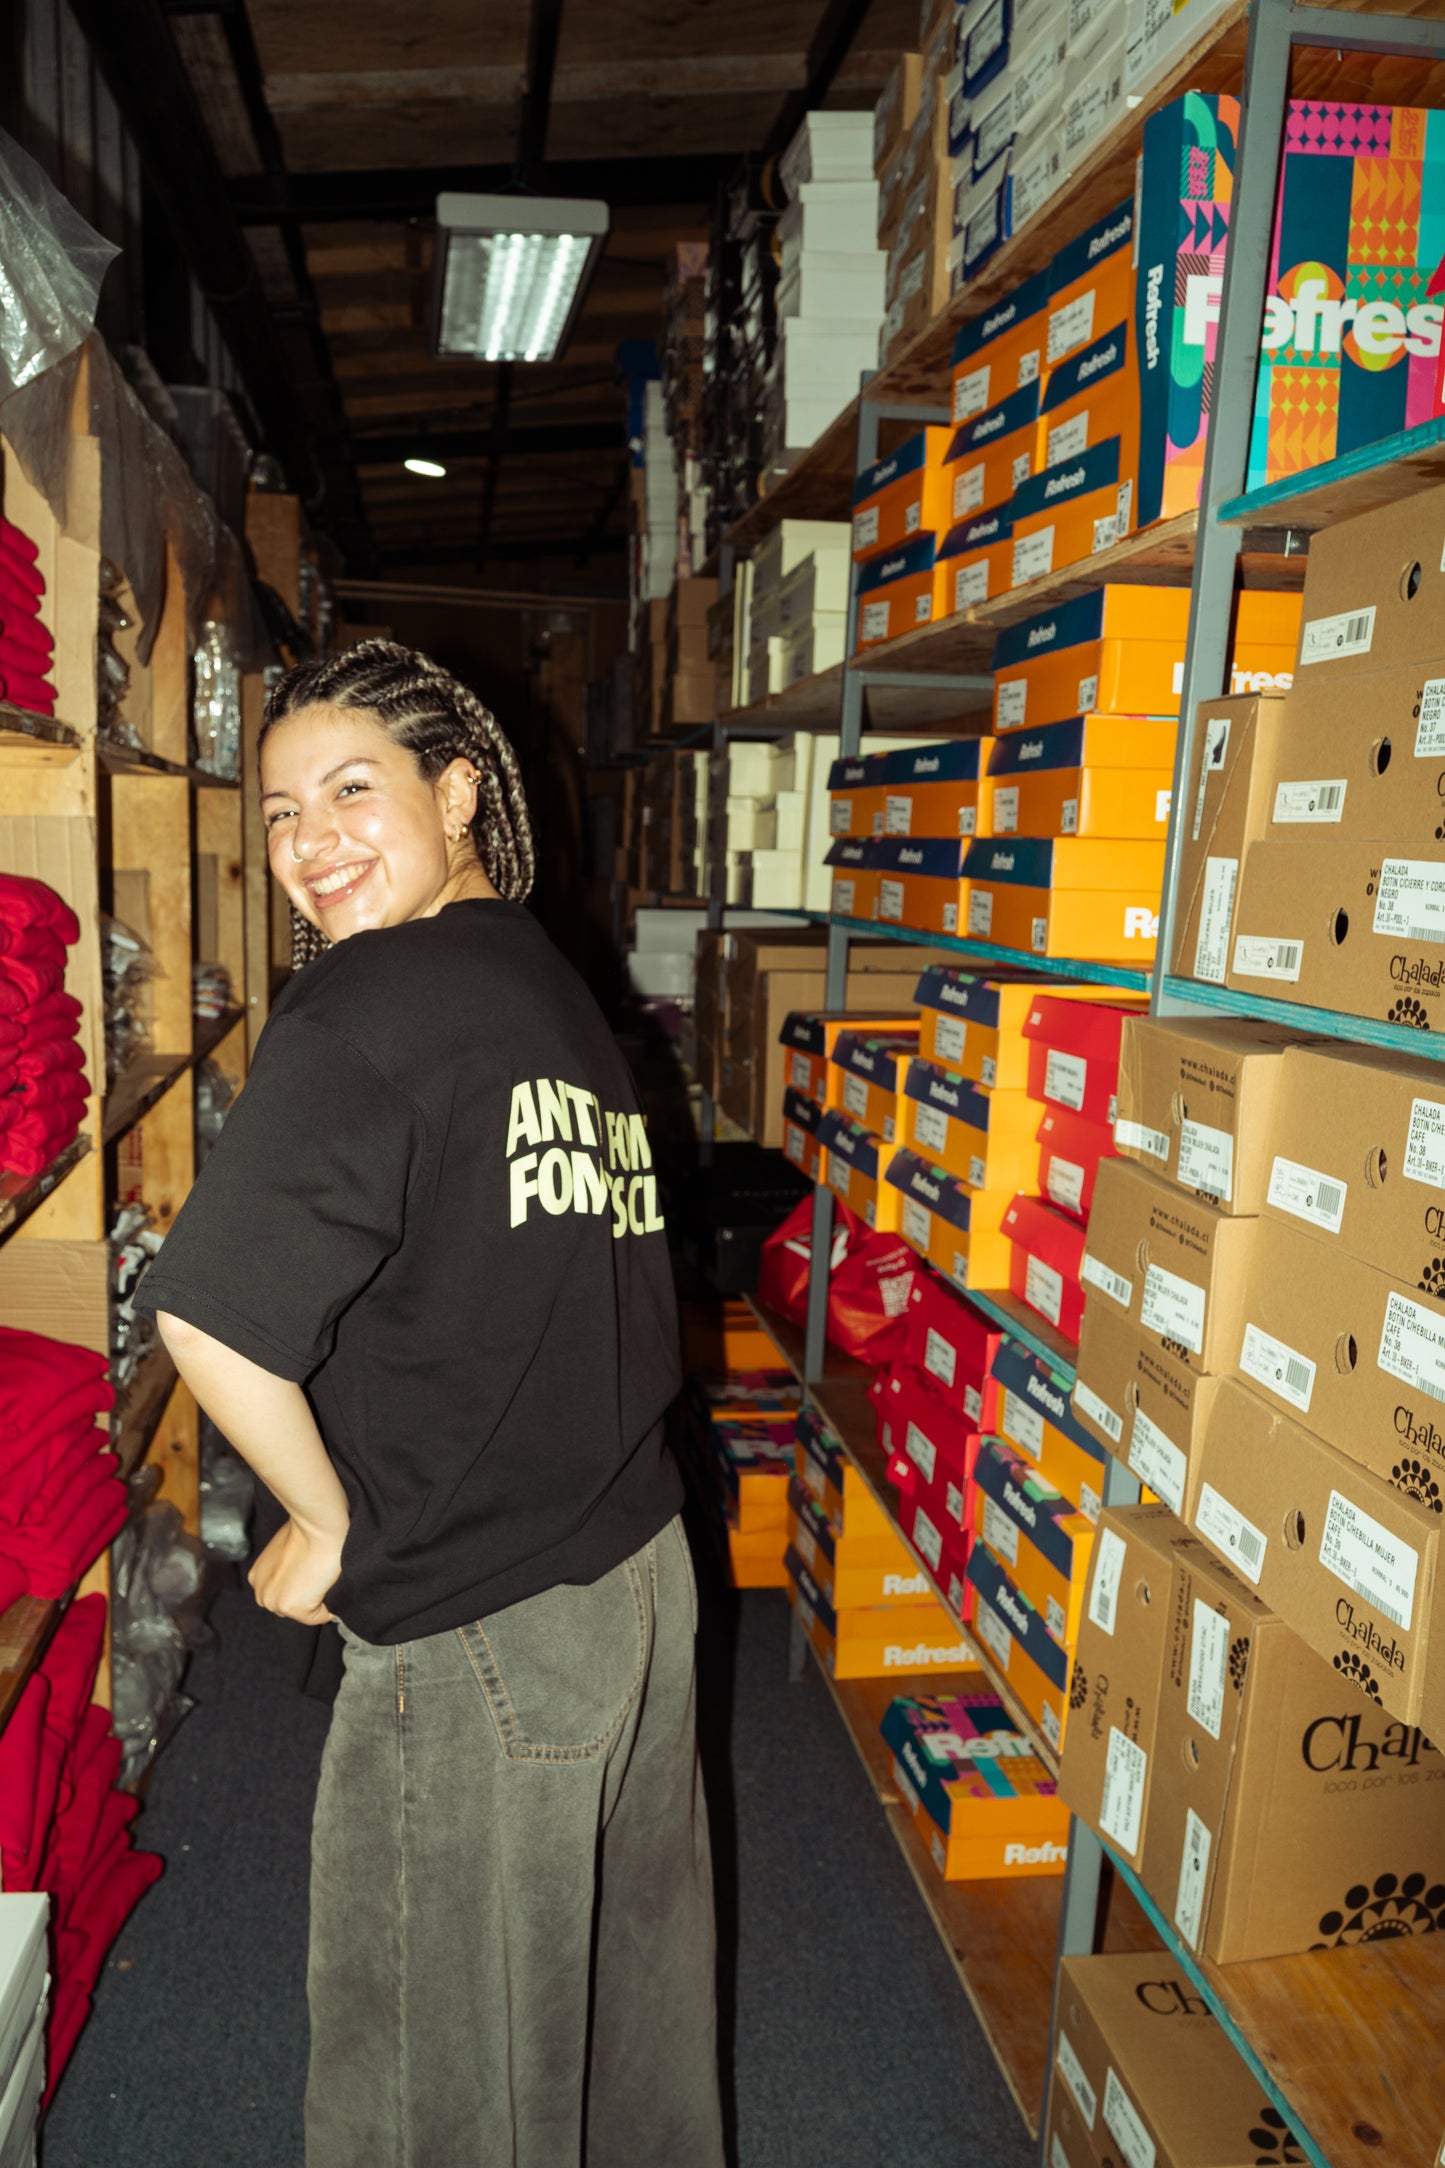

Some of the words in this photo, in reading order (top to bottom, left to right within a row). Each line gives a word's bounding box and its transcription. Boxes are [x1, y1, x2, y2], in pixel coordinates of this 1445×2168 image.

[1088, 214, 1132, 259] Refresh
[1145, 264, 1164, 370] Refresh
[1077, 343, 1117, 382] Refresh
[1044, 466, 1086, 499] Refresh
[1382, 876, 1398, 887] BOTIN
[1384, 864, 1409, 876] CHALADA
[1381, 888, 1399, 899] NEGRO
[1412, 1117, 1430, 1131] BOTIN
[1414, 1104, 1441, 1120] CHALADA
[1411, 1129, 1425, 1143] CAFE
[1388, 1310, 1405, 1327] BOTIN
[1390, 1297, 1416, 1319] CHALADA
[1386, 1321, 1401, 1338] CAFE
[1026, 1374, 1066, 1418] Refresh
[1003, 1481, 1036, 1528] Refresh
[1331, 1496, 1356, 1522] CHALADA
[1327, 1519, 1341, 1537] CAFE
[1329, 1508, 1345, 1527] BOTIN
[1375, 1543, 1396, 1566] MUJER
[996, 1584, 1029, 1636] Refresh
[1336, 1598, 1404, 1673] Chalada
